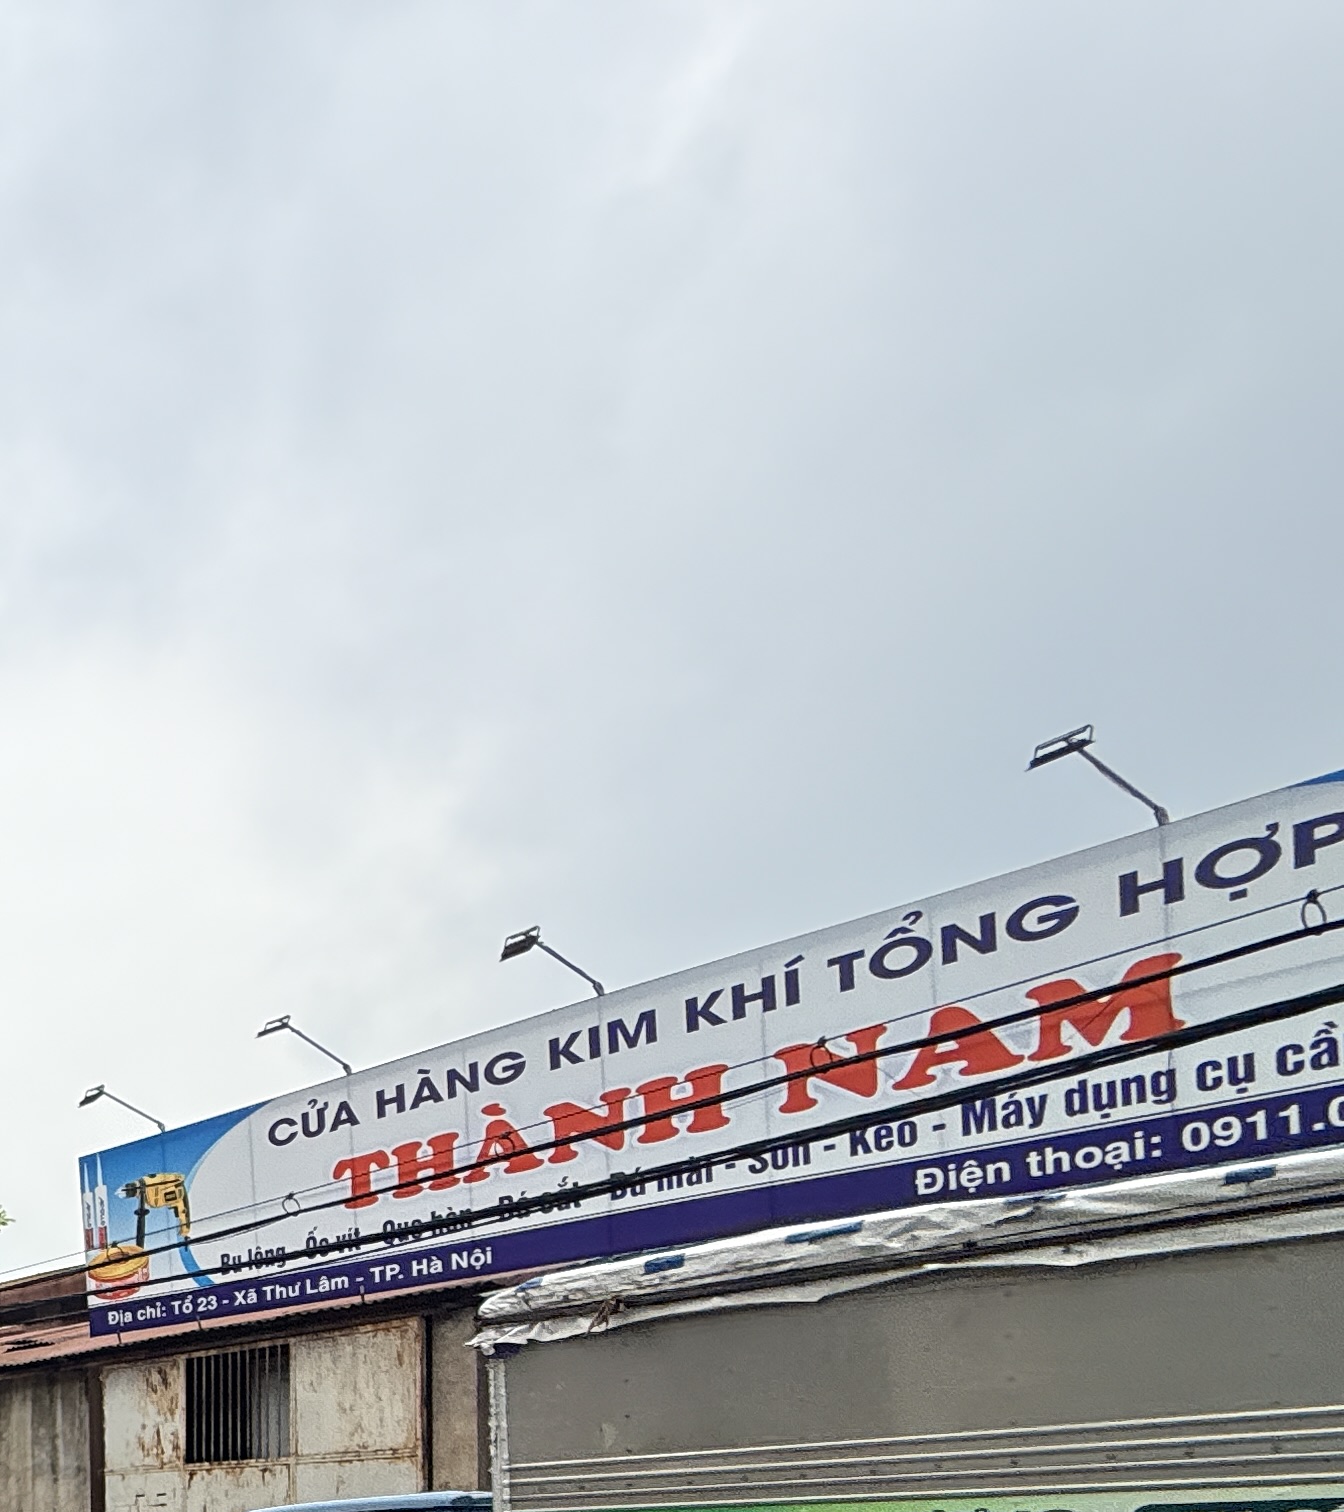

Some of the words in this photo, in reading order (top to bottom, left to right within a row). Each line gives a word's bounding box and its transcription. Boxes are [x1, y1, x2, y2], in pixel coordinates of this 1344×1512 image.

[268, 1098, 360, 1147] CỬA
[376, 1050, 526, 1120] HÀNG
[548, 1009, 657, 1071] KIM
[685, 954, 805, 1033] KHÍ
[827, 895, 1080, 992] TỔNG
[1119, 811, 1344, 918] HỢP
[332, 1063, 731, 1210] THÀNH
[773, 953, 1191, 1115] NAM
[962, 1091, 1049, 1137] Máy
[1064, 1066, 1178, 1119] dụng
[1195, 1052, 1256, 1094] cụ
[915, 1158, 1011, 1195] Điện
[1026, 1131, 1163, 1179] thoại:
[108, 1309, 133, 1327] Địa
[137, 1302, 168, 1323] chỉ:
[171, 1297, 194, 1316] Tổ
[197, 1295, 219, 1313] 23
[233, 1288, 258, 1307] Xã
[262, 1282, 302, 1302] Thư
[305, 1274, 350, 1295] Lâm
[369, 1264, 404, 1284] TP.
[411, 1255, 444, 1278] Hà
[451, 1246, 493, 1273] Nội
